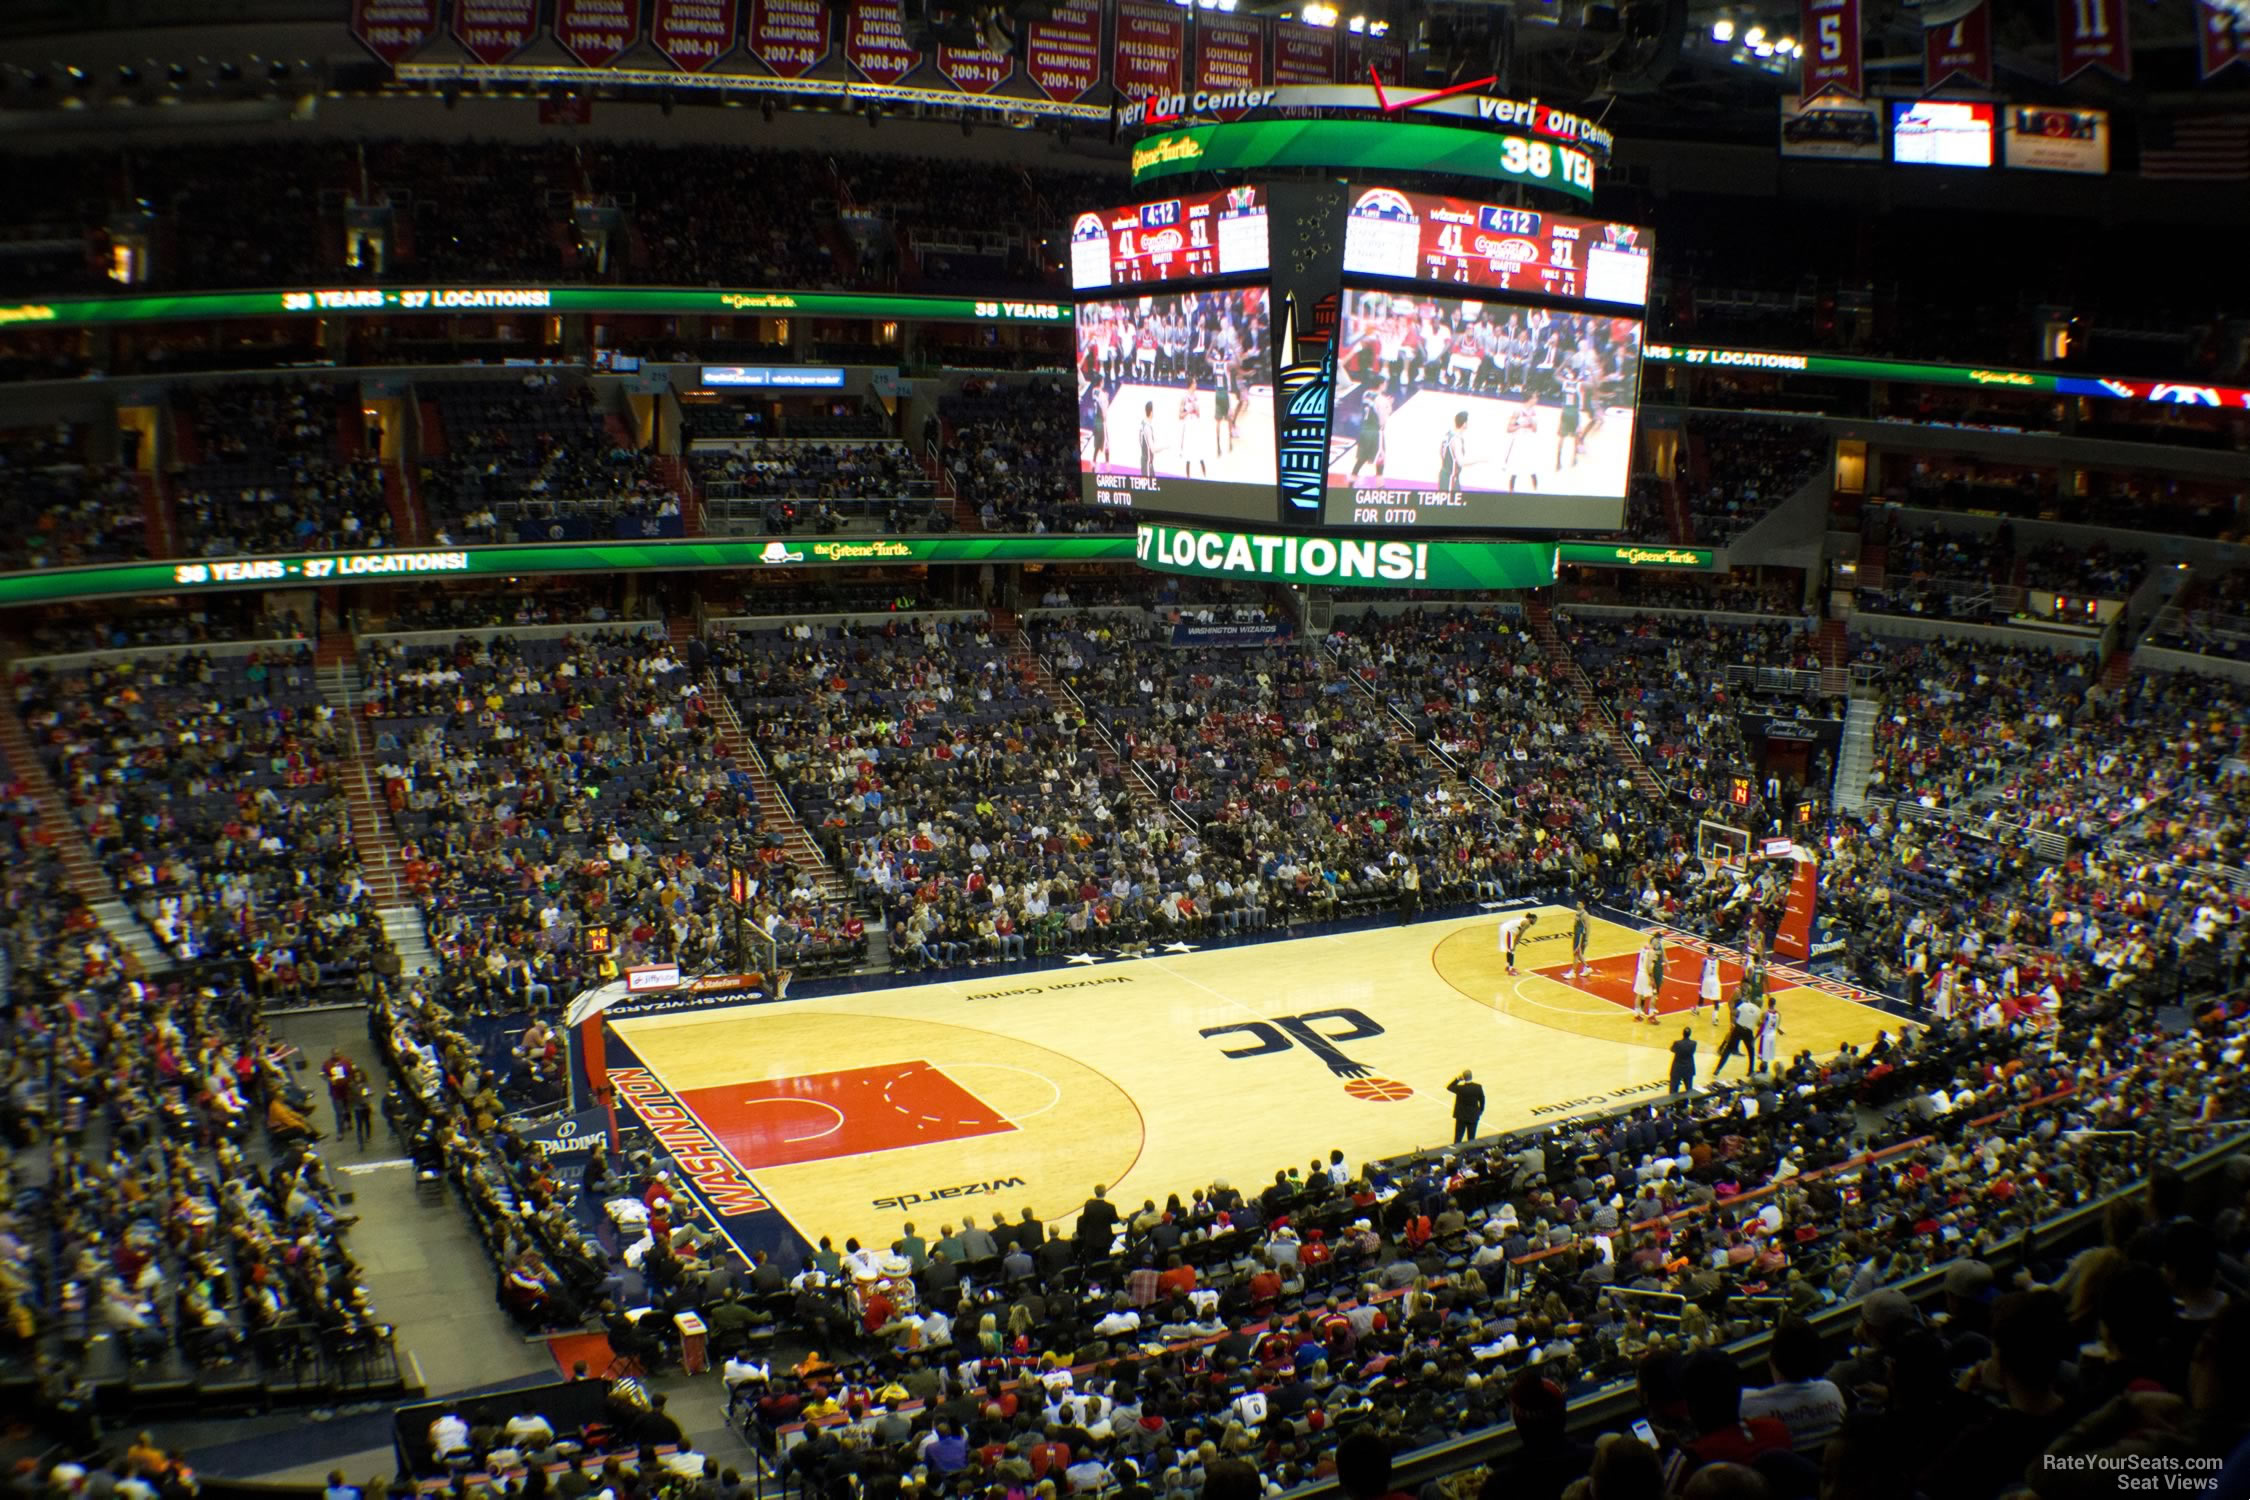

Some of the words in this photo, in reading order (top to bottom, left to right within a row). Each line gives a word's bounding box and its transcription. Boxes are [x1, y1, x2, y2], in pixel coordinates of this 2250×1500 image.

[767, 13, 816, 28] DIVISION
[1052, 10, 1087, 24] APITALS
[1121, 4, 1181, 23] WASHINGTON
[663, 17, 724, 35] CHAMPIONS
[862, 21, 901, 36] DIVISIO
[1131, 19, 1170, 35] CAPITALS
[1200, 15, 1259, 34] WASHINGTON
[759, 26, 821, 43] CHAMPIONS
[855, 34, 910, 50] CHAMPION
[1211, 30, 1248, 47] CAPITALS
[1278, 26, 1333, 45] WASHINGTON
[1818, 13, 1841, 61] 5
[667, 38, 718, 57] 2000-01
[763, 46, 815, 65] 2007-08
[1119, 40, 1179, 60] PRESIDENTS'
[1206, 47, 1252, 64] SOUTHEAST
[1287, 41, 1322, 57] CAPITALS
[859, 54, 910, 71] 2008-09
[1038, 53, 1090, 71] CHAMPIONS
[1130, 57, 1168, 74] TROPHY
[1210, 61, 1248, 76] DIVISION
[951, 65, 999, 82] 2009-10
[1042, 72, 1087, 90] 2009-10
[1203, 72, 1252, 89] CHAMPIONS
[1127, 82, 1171, 99] 2009-10
[1117, 92, 1185, 126] verizon
[1192, 90, 1276, 111] Center
[1478, 97, 1578, 141] verizon
[1501, 136, 1551, 178] 38
[1147, 203, 1174, 226] 4:12
[1490, 208, 1531, 234] 4:12
[1438, 224, 1462, 257] 41
[1552, 224, 1580, 240] BUCKS
[1120, 230, 1136, 259] 41
[1550, 239, 1574, 269] 31
[1453, 269, 1460, 282] 4
[1489, 259, 1521, 274] QUARTER
[1501, 272, 1510, 289] 2
[1544, 280, 1551, 293] 4
[1561, 281, 1568, 294] 4
[282, 292, 312, 310] 38
[314, 289, 385, 308] YEARS
[400, 290, 431, 308] 37
[432, 289, 550, 307] LOCATIONS!
[975, 301, 999, 317] 38
[1003, 302, 1059, 319] YEARS
[1642, 344, 1672, 359] ARS
[1685, 348, 1709, 363] 37
[1710, 350, 1808, 370] LOCATIONS!
[1096, 474, 1127, 489] GARRETT
[1129, 477, 1160, 492] TEMPLE.
[1096, 491, 1111, 504] FOR
[1113, 491, 1132, 506] OTTO
[1355, 490, 1411, 505] GARRETT
[1417, 491, 1468, 507] TEMPLE.
[1353, 508, 1378, 523] FOR
[1385, 509, 1416, 524] OTTO
[814, 543, 830, 555] the
[829, 543, 874, 561] Greene
[1136, 526, 1153, 562] 37
[1157, 528, 1429, 581] LOCATIONS!
[1615, 548, 1629, 559] the
[1628, 547, 1667, 564] Greene
[211, 561, 286, 581] YEARS
[303, 559, 335, 578] 37
[337, 553, 469, 575] LOCATIONS!
[1188, 626, 1238, 636] WASHINGTON
[1239, 625, 1277, 634] WIZARDS
[1518, 931, 1575, 947] izard
[1639, 925, 1883, 1002] WASHGTON
[1048, 977, 1135, 991] Verizon
[965, 987, 1044, 1002] Center
[1608, 1079, 1670, 1098] erizon
[1531, 1095, 1608, 1117] Center
[533, 1131, 608, 1157] PALDING
[606, 1067, 770, 1216] WASHINGTON
